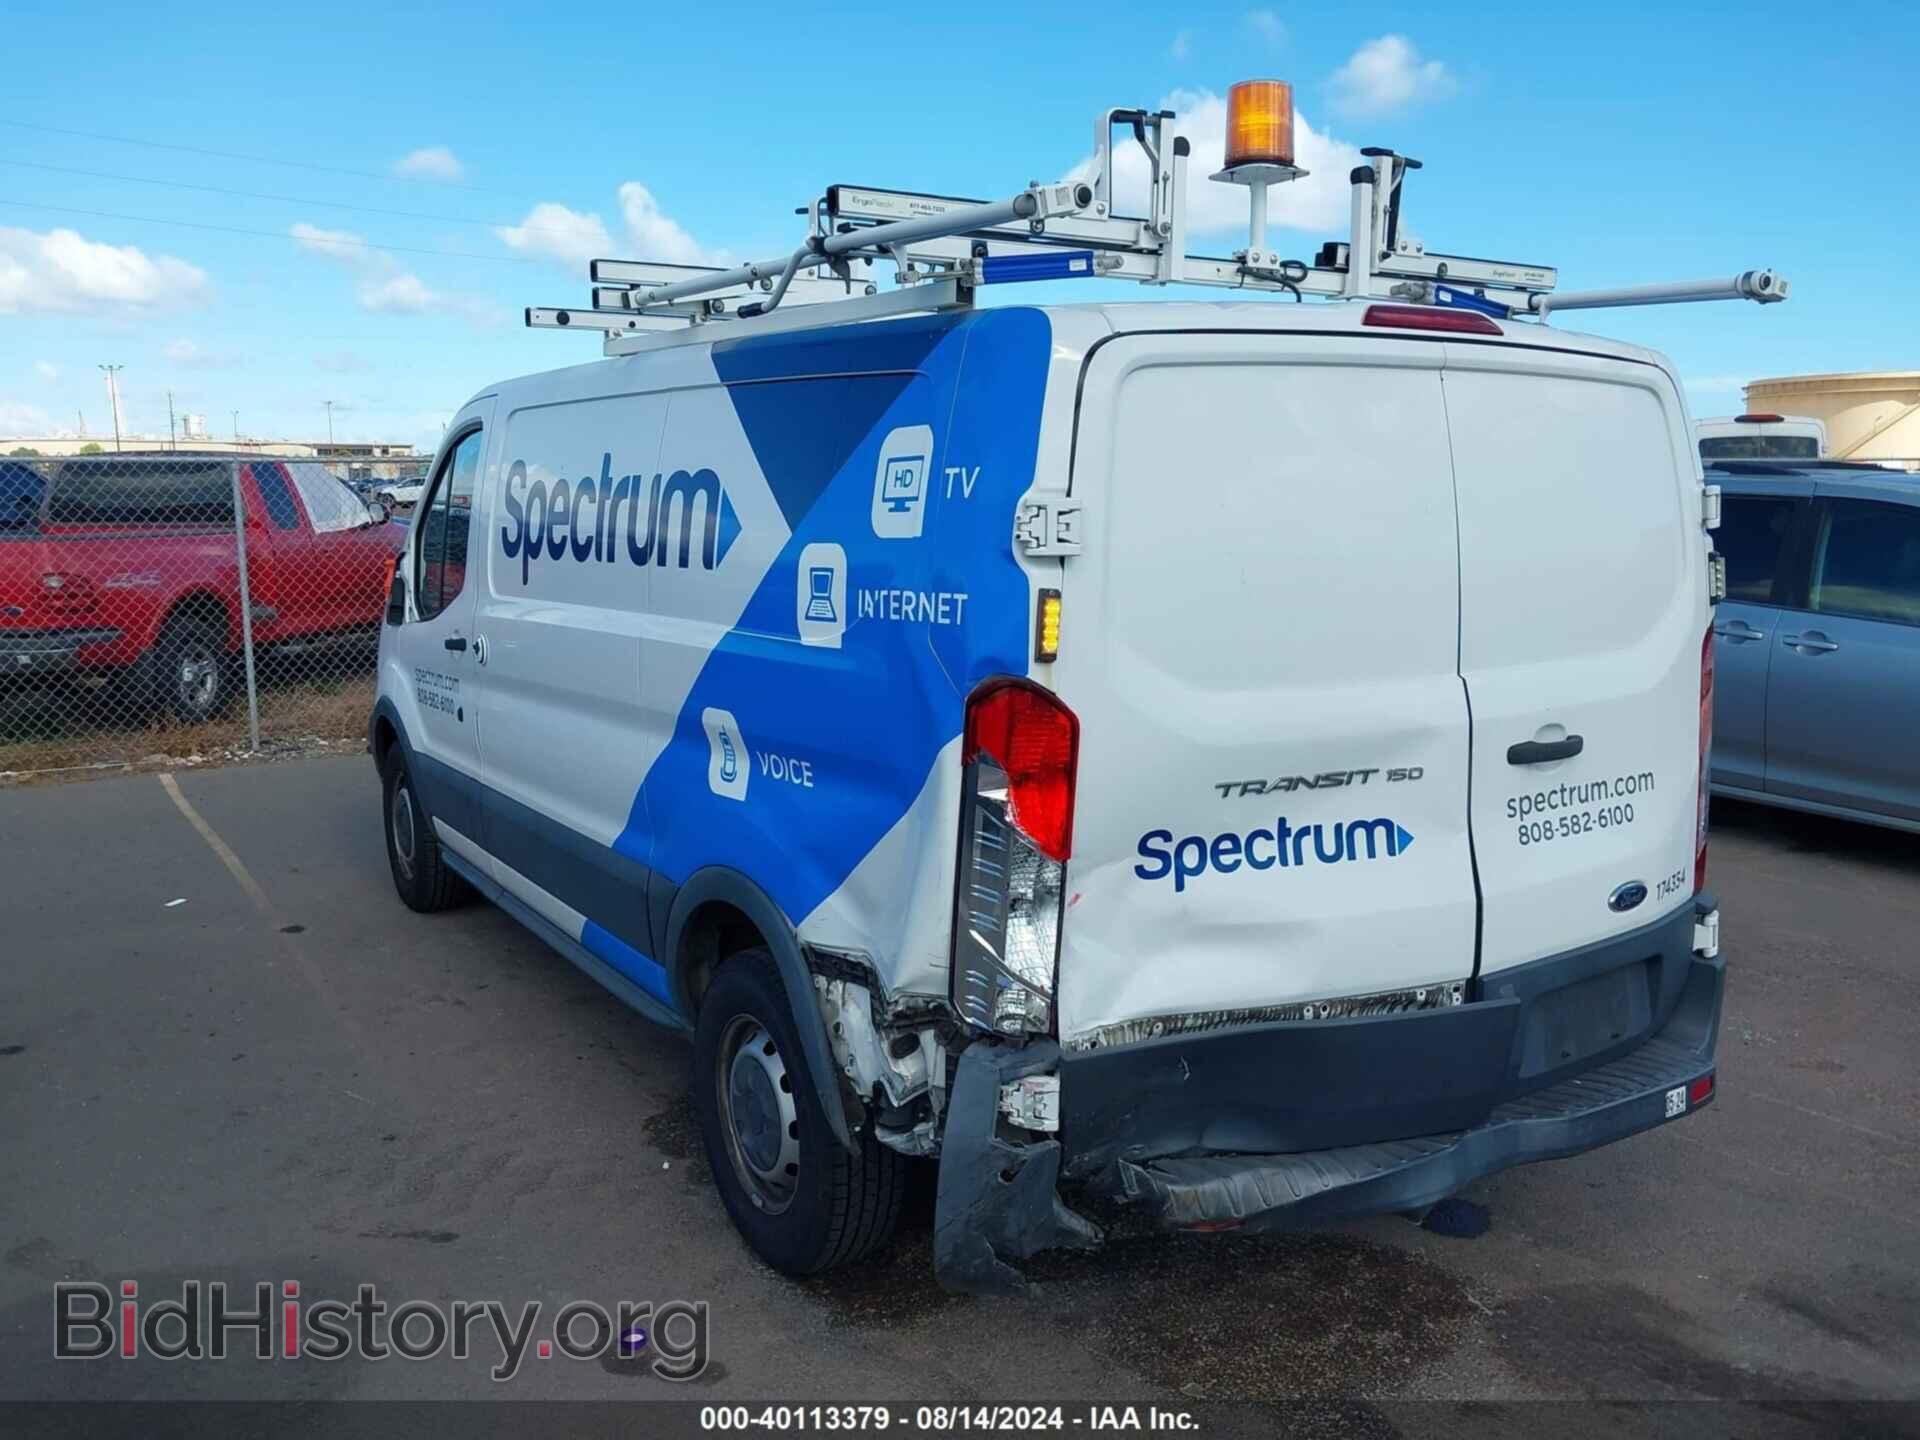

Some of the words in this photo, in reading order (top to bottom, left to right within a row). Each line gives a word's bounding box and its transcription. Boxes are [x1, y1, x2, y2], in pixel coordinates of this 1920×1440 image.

[894, 469, 913, 488] HD
[945, 466, 981, 499] TV
[502, 453, 722, 585] Spectrum
[858, 589, 969, 625] INTERNET
[756, 751, 814, 787] VOICE
[1215, 768, 1380, 798] TRANSIT
[1386, 766, 1424, 782] 150
[1506, 771, 1655, 822] spectrum.com
[1518, 803, 1634, 845] 808-582-6100
[1134, 816, 1397, 892] Spectrum
[1656, 866, 1686, 903] 174354
